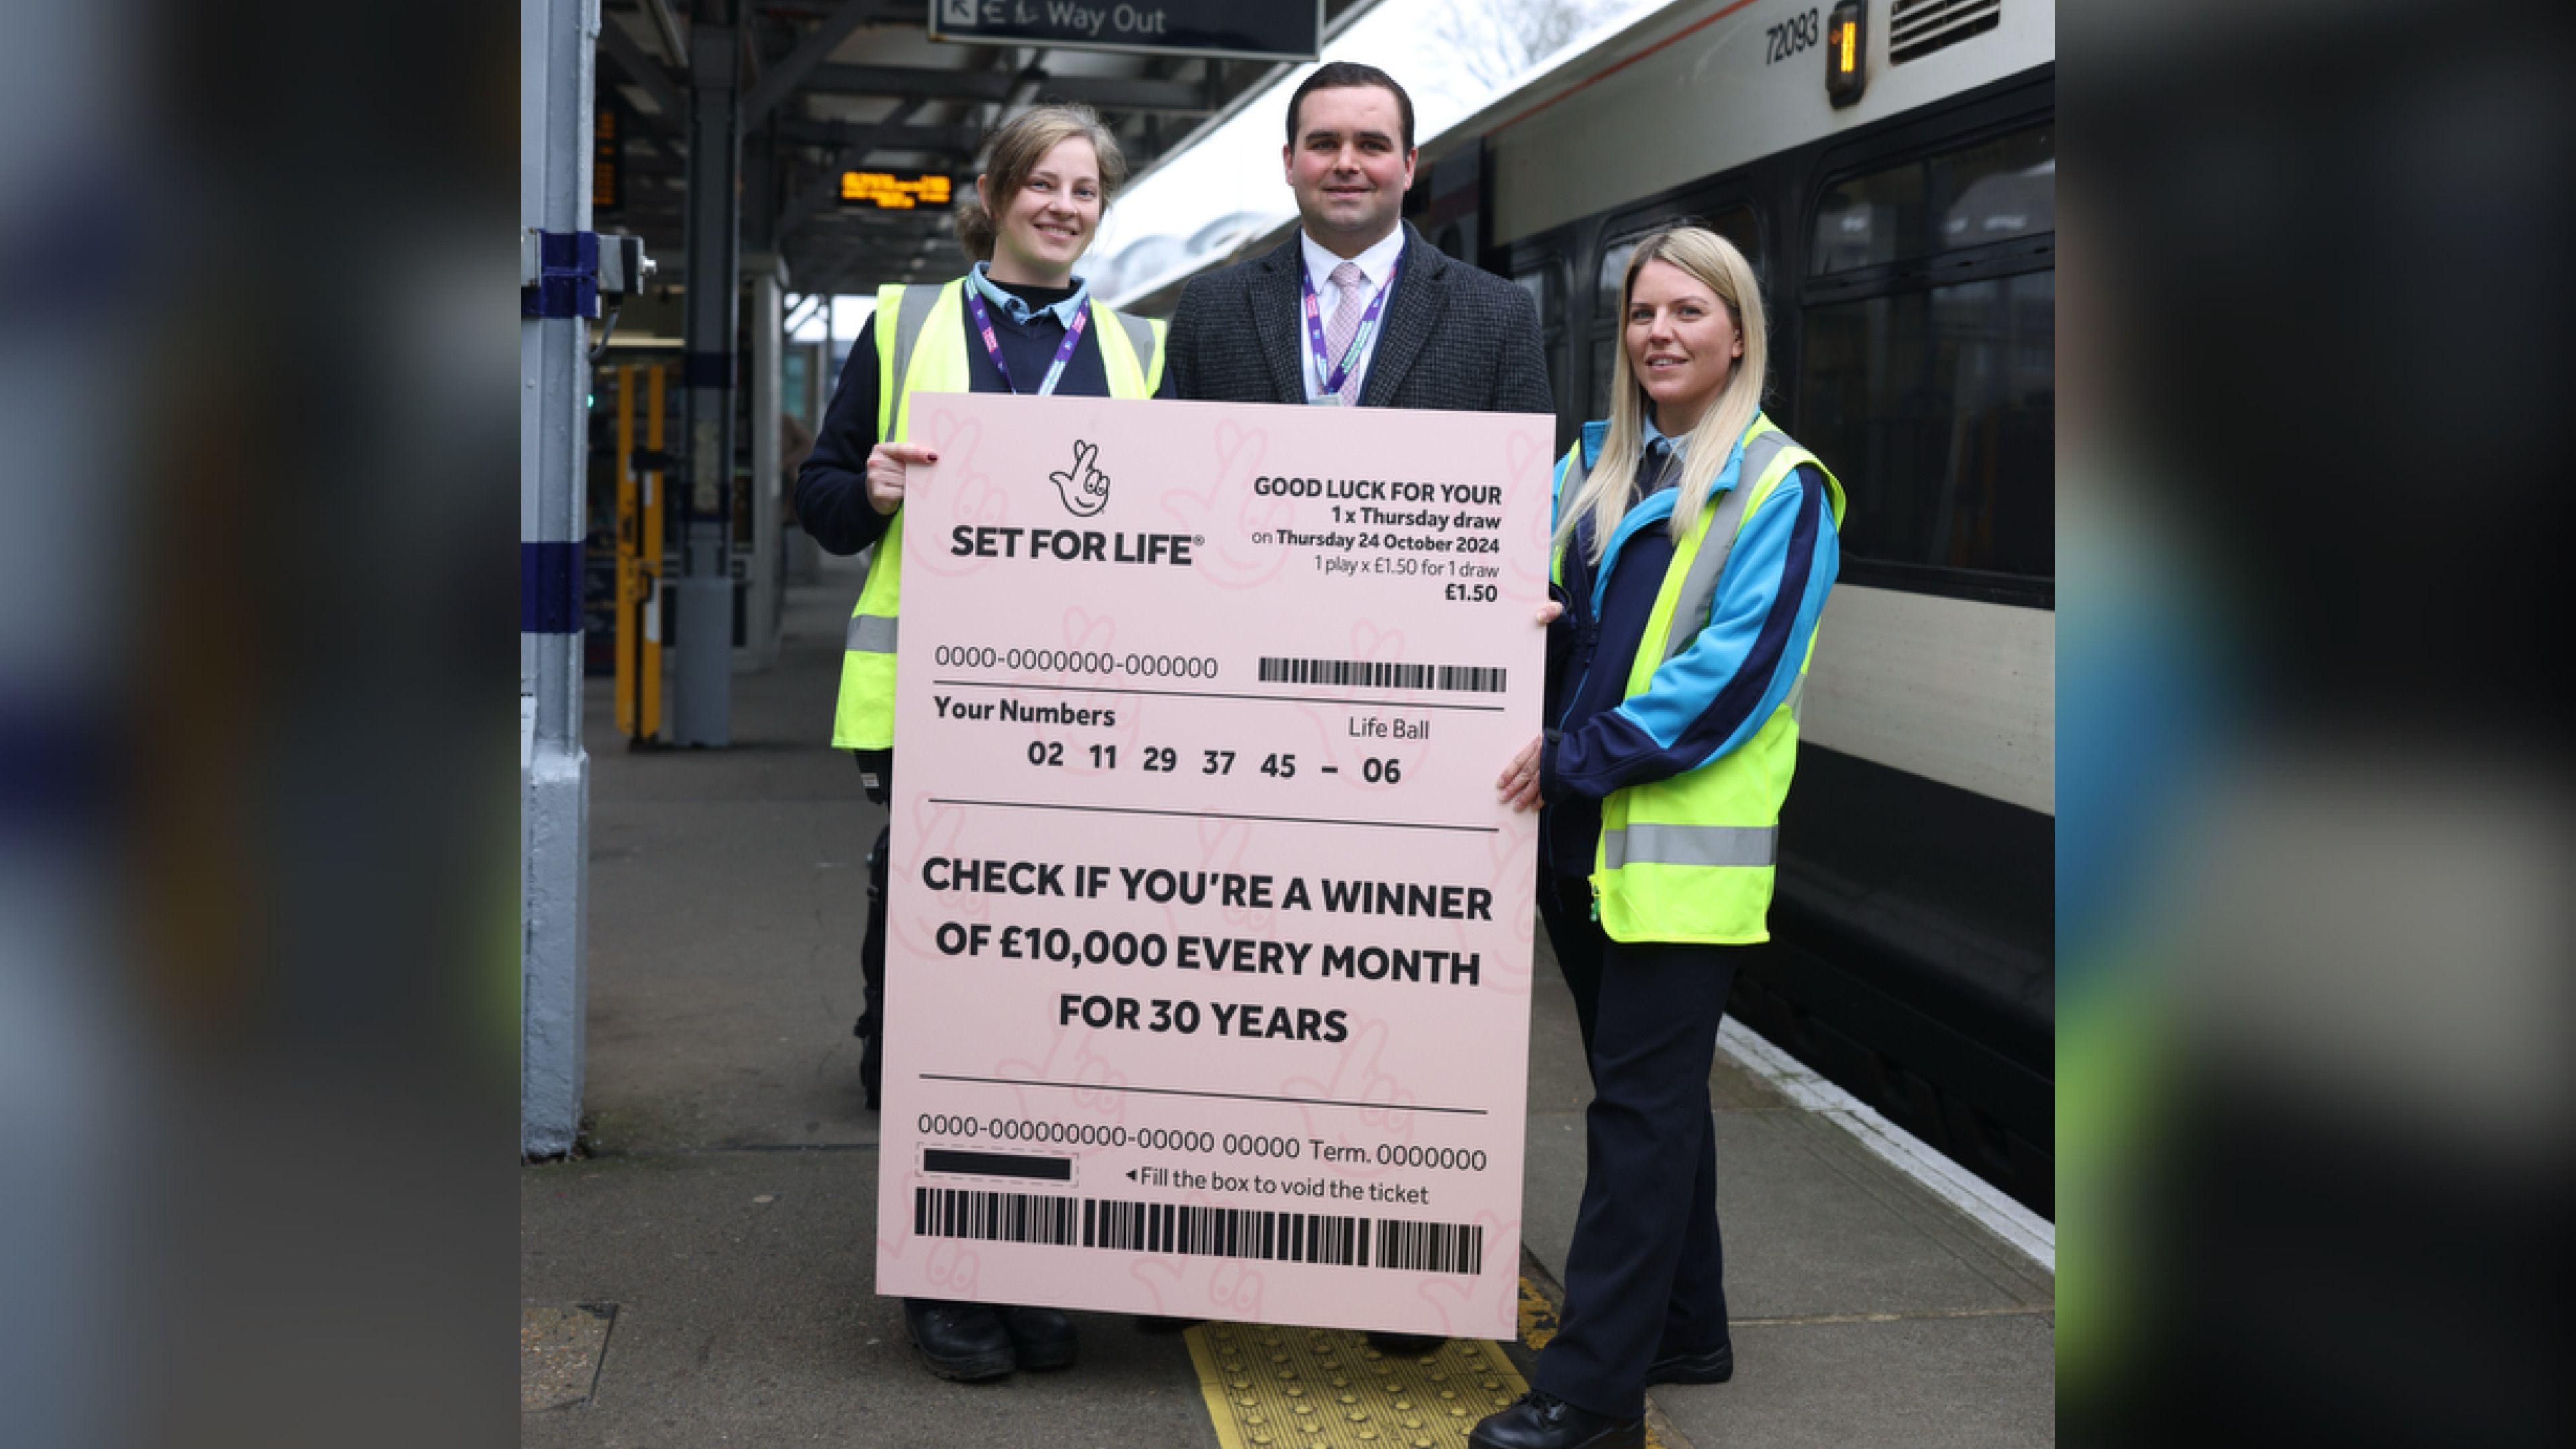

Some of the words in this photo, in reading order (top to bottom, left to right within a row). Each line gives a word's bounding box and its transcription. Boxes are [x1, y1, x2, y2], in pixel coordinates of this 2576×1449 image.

[1047, 0, 1106, 36] Way
[1113, 4, 1166, 34] Out
[1766, 7, 1819, 66] 72093
[1254, 476, 1322, 497] GOOD
[1326, 479, 1385, 501] LUCK
[1391, 482, 1435, 502] FOR
[1440, 484, 1502, 506] YOUR
[1332, 505, 1340, 523] 1
[1346, 511, 1356, 524] x
[1359, 506, 1450, 531] Thursday
[1453, 511, 1502, 530] draw
[950, 525, 1025, 557] SET
[1030, 529, 1107, 562] FOR
[1252, 531, 1273, 544] on
[1276, 529, 1356, 552] Thursday
[1358, 531, 1381, 548] 24
[1383, 533, 1453, 552] October
[1456, 536, 1500, 553] 2024
[1316, 554, 1320, 569] 1
[1326, 556, 1358, 576] play
[1362, 561, 1369, 572] x
[1375, 557, 1417, 575] £1.50
[1421, 559, 1444, 576] for
[1449, 561, 1455, 576] 1
[1458, 563, 1500, 578] draw
[1444, 583, 1498, 602] £1.50
[934, 644, 1218, 679] 0000-0000000-000000
[932, 695, 995, 721] Your
[1000, 698, 1116, 727] Numbers
[1349, 716, 1388, 737] Life
[1393, 718, 1429, 739] Ball
[1027, 740, 1064, 767] 02
[1089, 743, 1116, 769] 11
[1143, 745, 1177, 773] 29
[1202, 749, 1237, 775] 37
[1260, 752, 1295, 779] 45
[1363, 757, 1401, 784] 06
[921, 855, 1066, 897] CHECK
[1074, 865, 1111, 899] IF
[1281, 877, 1312, 911] A
[1321, 878, 1493, 922] WINNER
[934, 920, 992, 957] OF
[998, 925, 1167, 969] £10,000
[1177, 936, 1313, 976] EVERY
[1321, 943, 1481, 987] MONTH
[1059, 992, 1140, 1030] FOR
[1148, 998, 1201, 1034] 30
[1210, 1002, 1349, 1044] YEARS
[917, 1113, 1215, 1153] 0000-000000000-00000
[1222, 1133, 1300, 1160] 00000
[1308, 1138, 1372, 1164] Term.
[1375, 1143, 1487, 1171] 0000000
[1141, 1165, 1169, 1187] Fill
[1173, 1169, 1208, 1190] the
[1211, 1171, 1249, 1192] box
[1254, 1175, 1277, 1194] to
[1281, 1177, 1325, 1198] void
[1329, 1179, 1365, 1199] the
[1368, 1182, 1428, 1205] ticket
